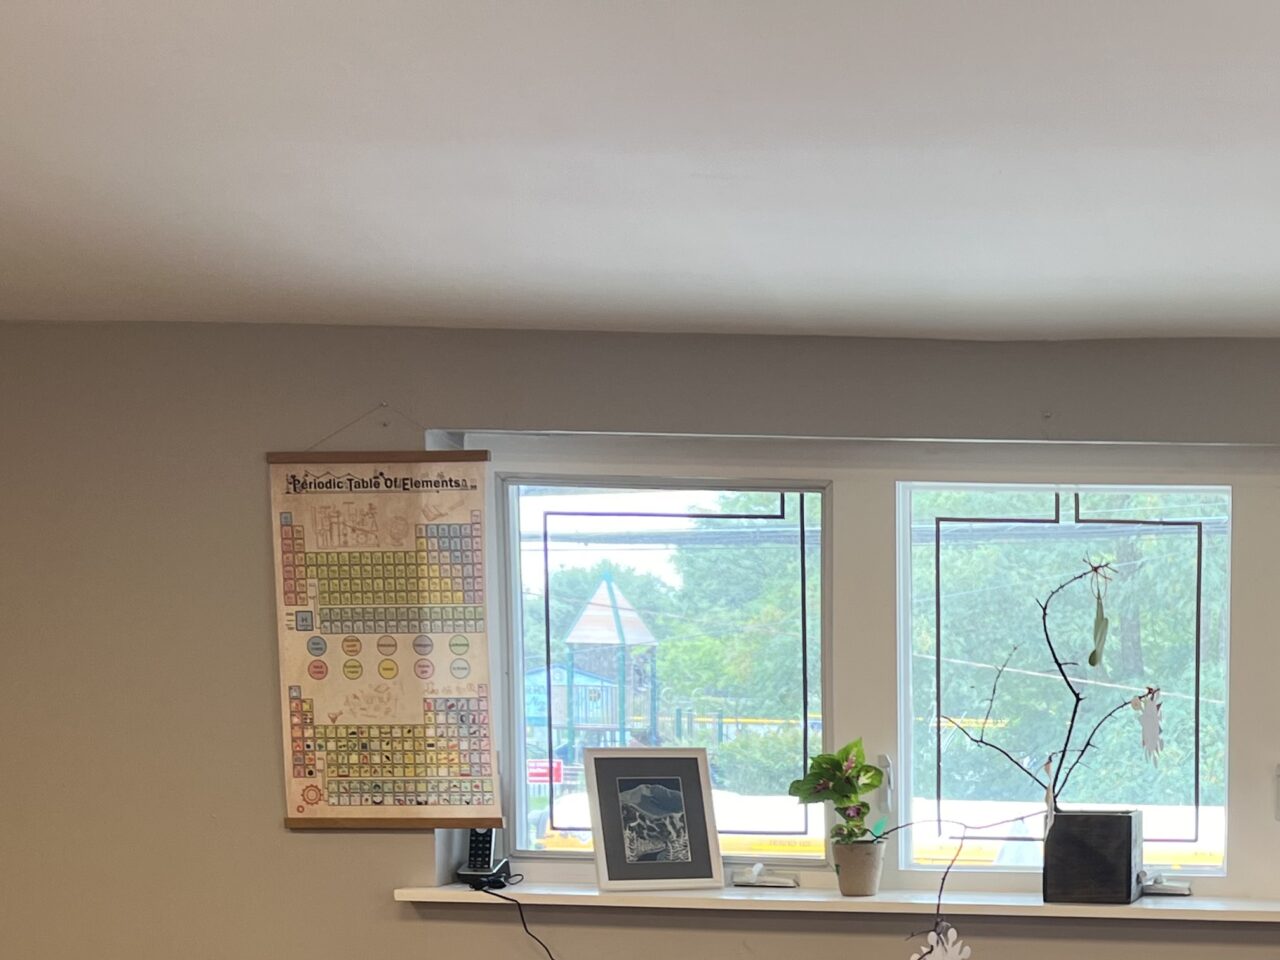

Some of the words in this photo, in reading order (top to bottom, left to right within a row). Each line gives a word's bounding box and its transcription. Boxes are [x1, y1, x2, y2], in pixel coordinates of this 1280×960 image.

[291, 477, 344, 492] Periodic
[347, 477, 380, 491] Table
[384, 477, 399, 489] Of
[402, 477, 461, 491] Elements
